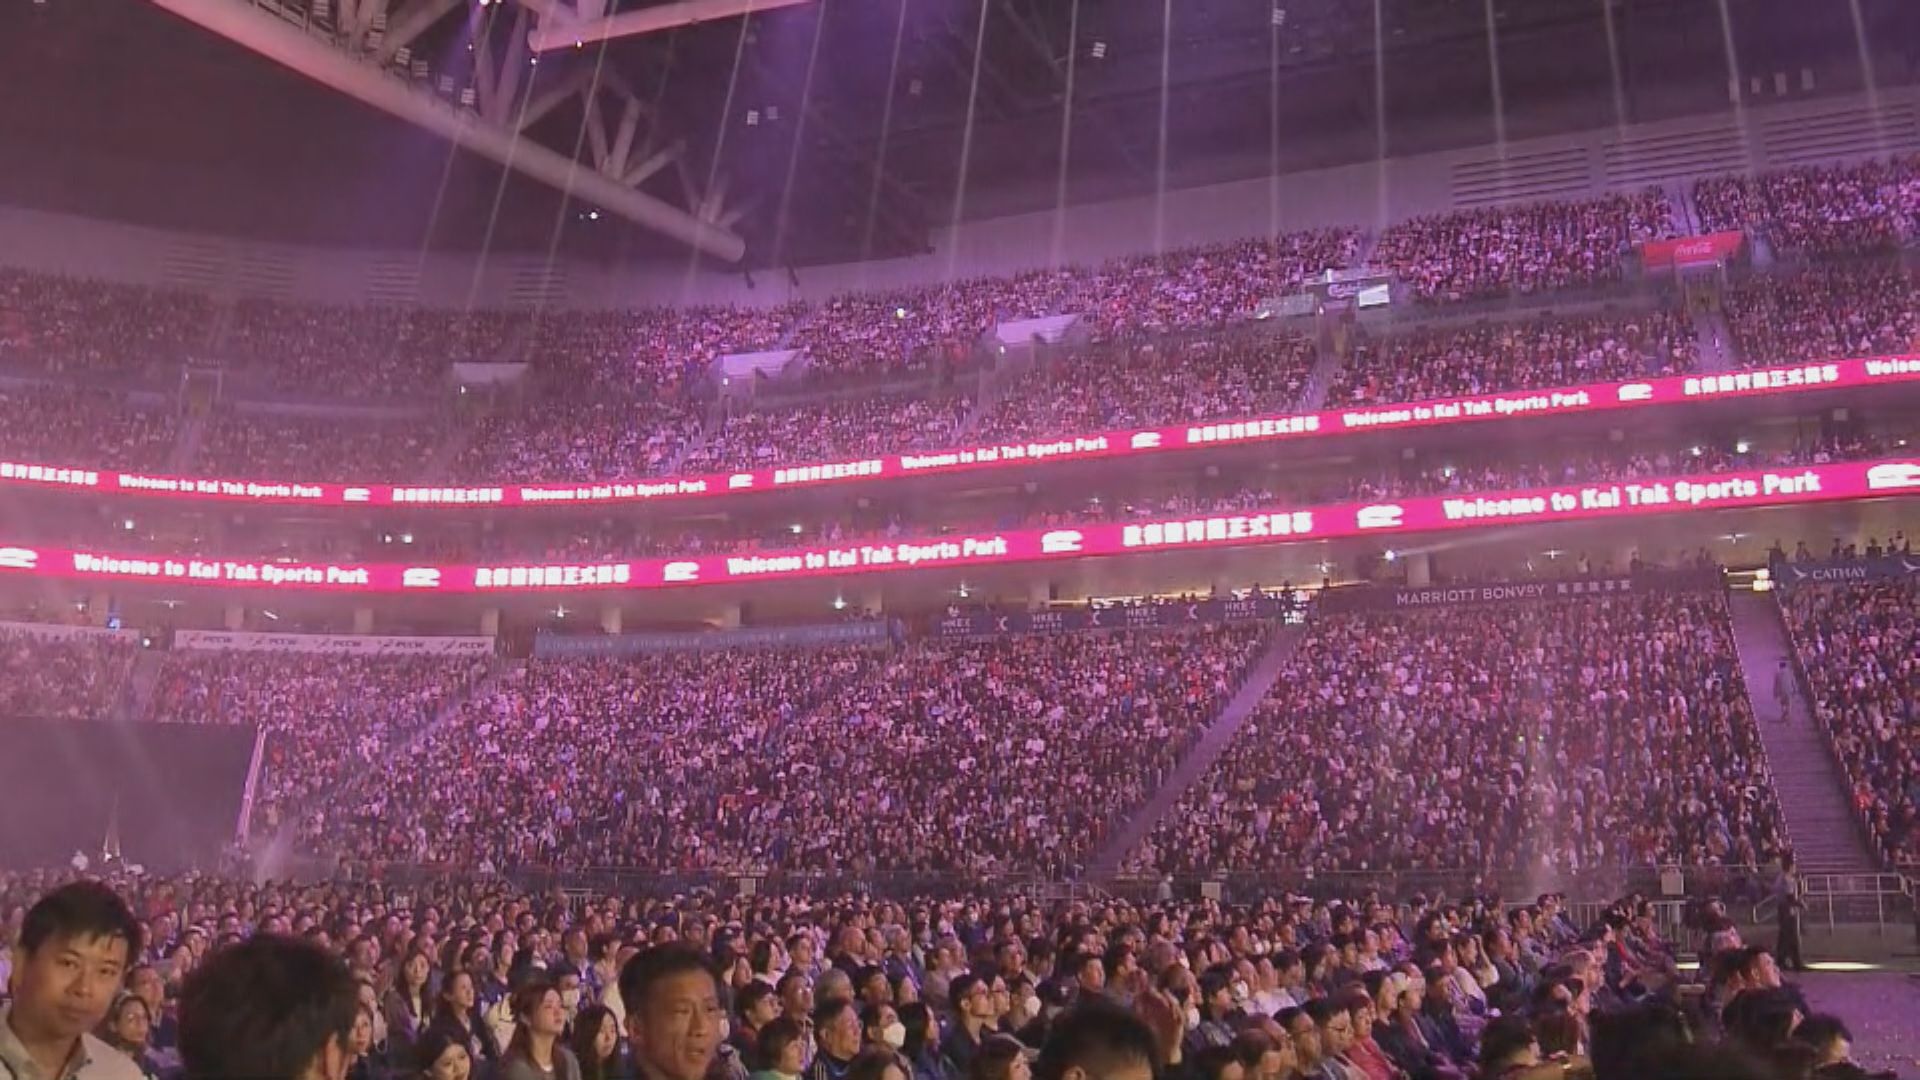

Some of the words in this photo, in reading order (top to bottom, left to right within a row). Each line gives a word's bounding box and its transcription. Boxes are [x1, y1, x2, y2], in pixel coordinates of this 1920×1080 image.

[1866, 358, 1920, 375] Welco
[1343, 410, 1410, 427] Welcome
[1413, 407, 1431, 419] to
[1434, 403, 1459, 418] Kai
[1463, 400, 1491, 415] Tak
[1495, 396, 1548, 415] Sports
[1552, 391, 1589, 407] Park
[960, 452, 974, 463] to
[1001, 445, 1024, 459] Tak
[1075, 436, 1107, 451] Park
[119, 475, 177, 490] Welcome
[179, 480, 194, 491] to
[197, 480, 218, 493] Kai
[577, 488, 590, 499] to
[1443, 497, 1545, 519] Welcome
[1551, 492, 1576, 511] to
[1581, 486, 1619, 509] Kai
[1625, 483, 1670, 505] Tak
[1675, 479, 1757, 505] Sports
[1764, 471, 1821, 495] Park
[728, 554, 802, 575] Welcome
[806, 552, 825, 569] to
[829, 549, 856, 567] Kai
[860, 545, 893, 565] Tak
[897, 542, 959, 565] Sports
[963, 537, 1006, 557] Park
[74, 554, 159, 575] Welcome
[165, 560, 184, 577] to
[189, 561, 219, 578] Kai
[224, 562, 257, 580] Tak
[261, 564, 322, 584] Sports
[327, 566, 368, 584] Park
[1812, 566, 1867, 580] CATHAY
[1396, 588, 1477, 605] MARRIOTT
[1482, 584, 1545, 600] BONVOY
